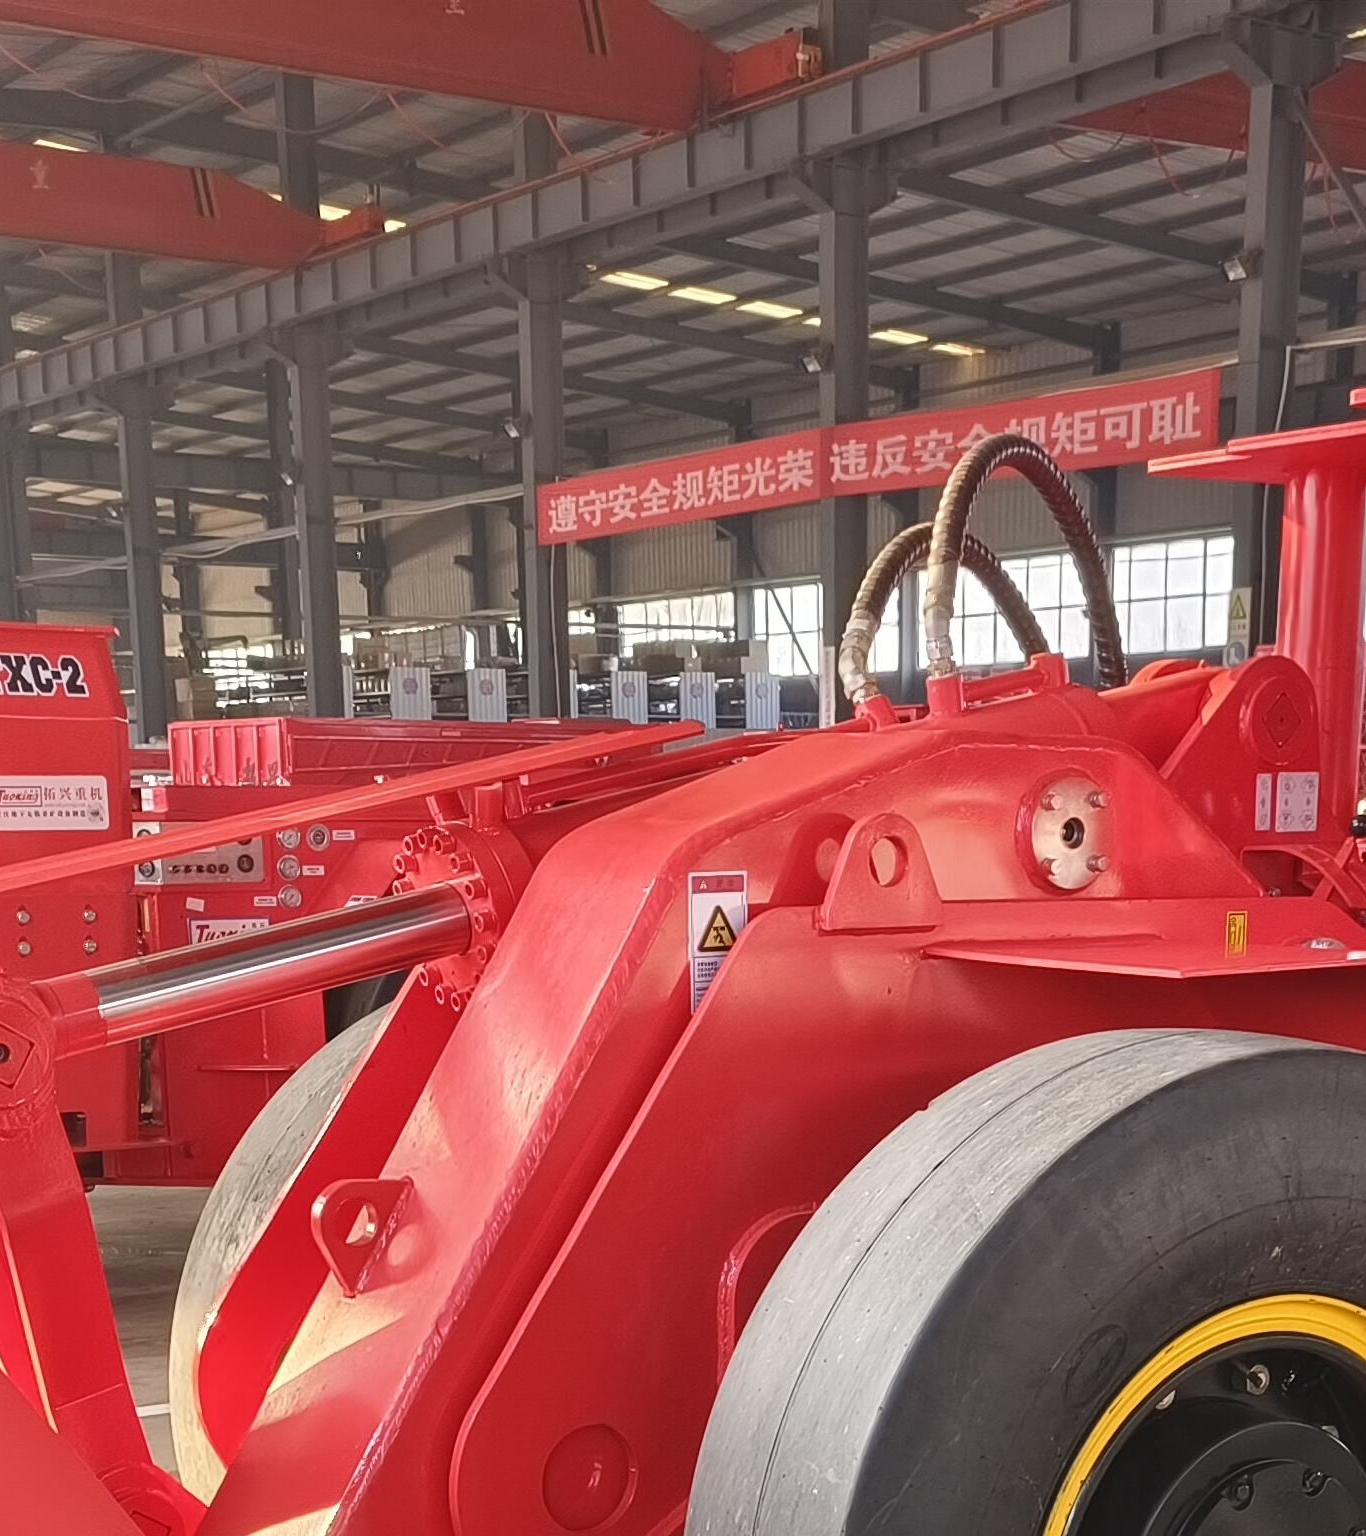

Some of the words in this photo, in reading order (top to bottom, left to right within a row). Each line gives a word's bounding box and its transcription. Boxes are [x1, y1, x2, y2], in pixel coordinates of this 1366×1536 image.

[548, 447, 815, 534] 遵守安全规矩光荣
